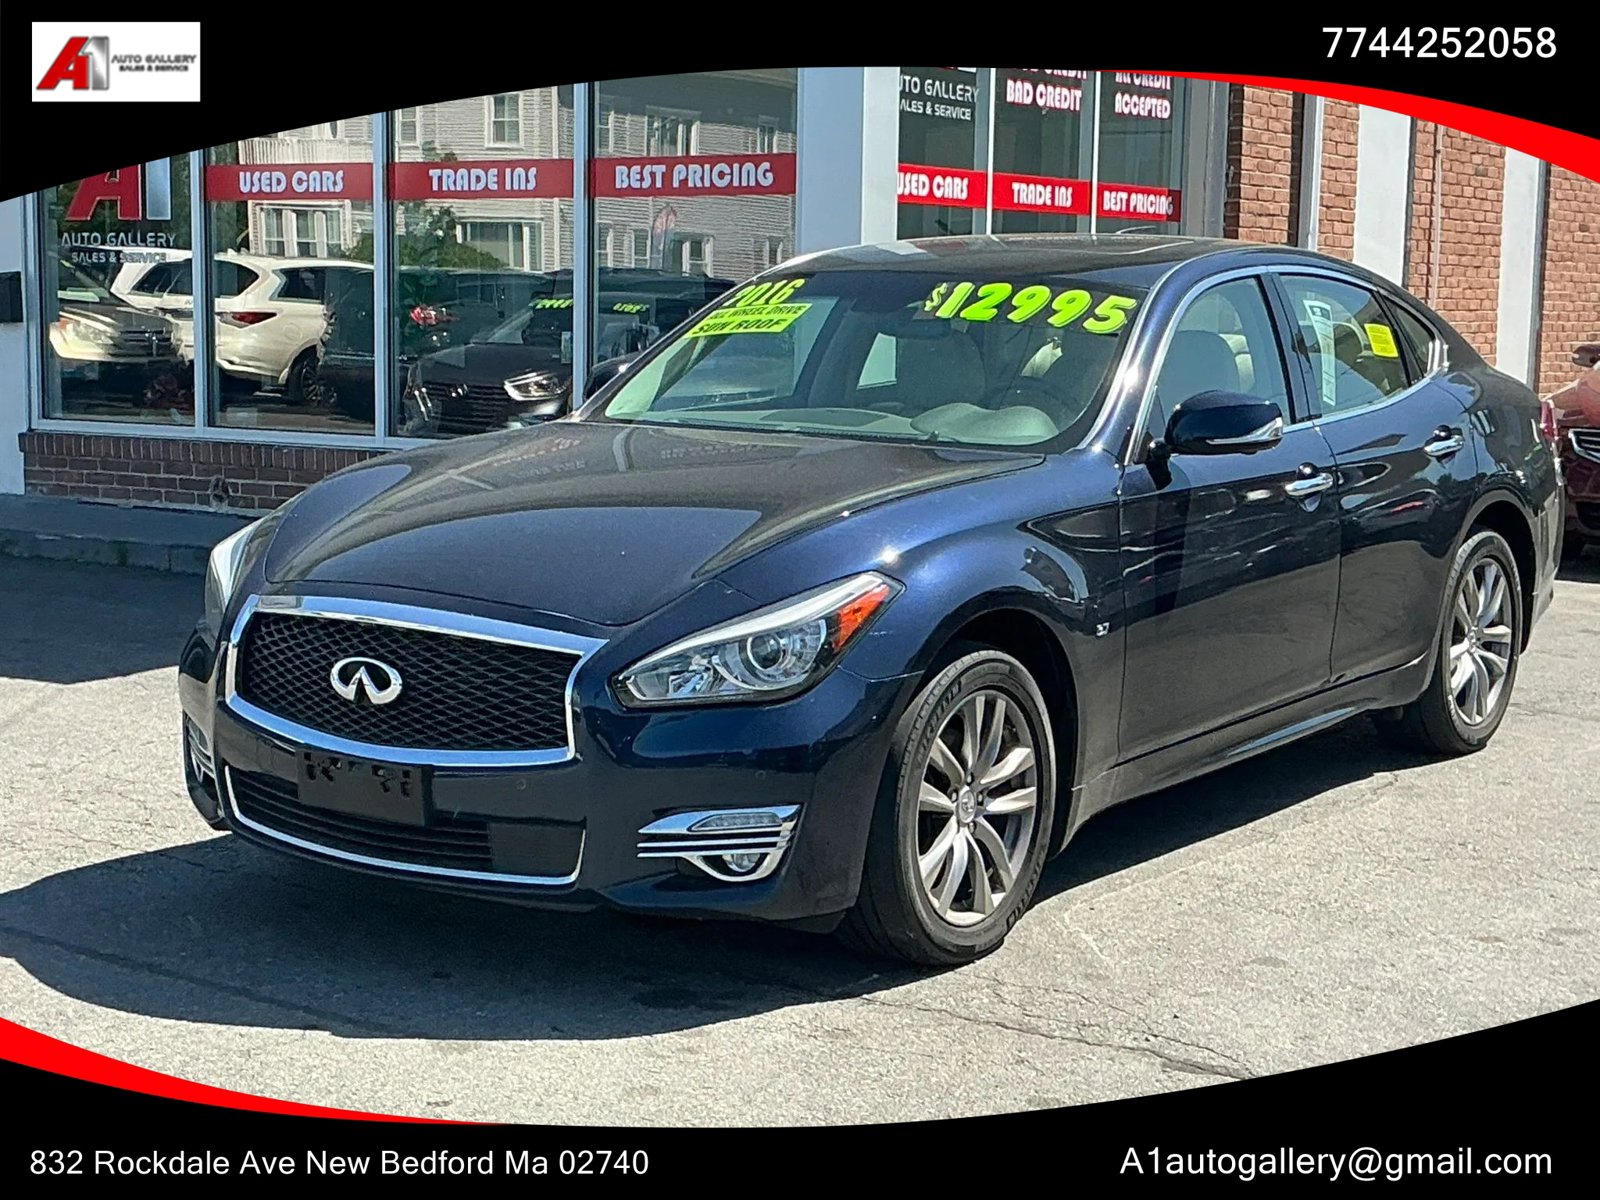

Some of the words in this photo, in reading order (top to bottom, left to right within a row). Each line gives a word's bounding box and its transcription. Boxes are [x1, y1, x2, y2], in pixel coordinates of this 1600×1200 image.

[924, 79, 980, 104] GALLERY
[1006, 78, 1034, 105] BAD
[1035, 83, 1082, 111] CREDIT
[934, 103, 972, 121] SERVICE
[1114, 91, 1171, 119] ACCEPTED
[238, 170, 287, 193] USED
[291, 169, 345, 193] CARS
[428, 168, 500, 192] TRADE
[505, 166, 537, 191] INS
[614, 164, 667, 190] BEST
[672, 161, 775, 188] PRICING
[932, 174, 969, 201] CARS
[1012, 181, 1052, 207] TRADE
[1054, 185, 1073, 208] INS
[1103, 190, 1129, 212] BEST
[1130, 192, 1174, 216] PRICING
[61, 231, 102, 247] AUTO
[105, 231, 177, 248] GALLERY
[71, 251, 107, 264] SALES
[108, 252, 117, 264] &
[119, 252, 168, 265] SERVICE
[924, 281, 1138, 335] $12995
[730, 318, 789, 331] ROOF
